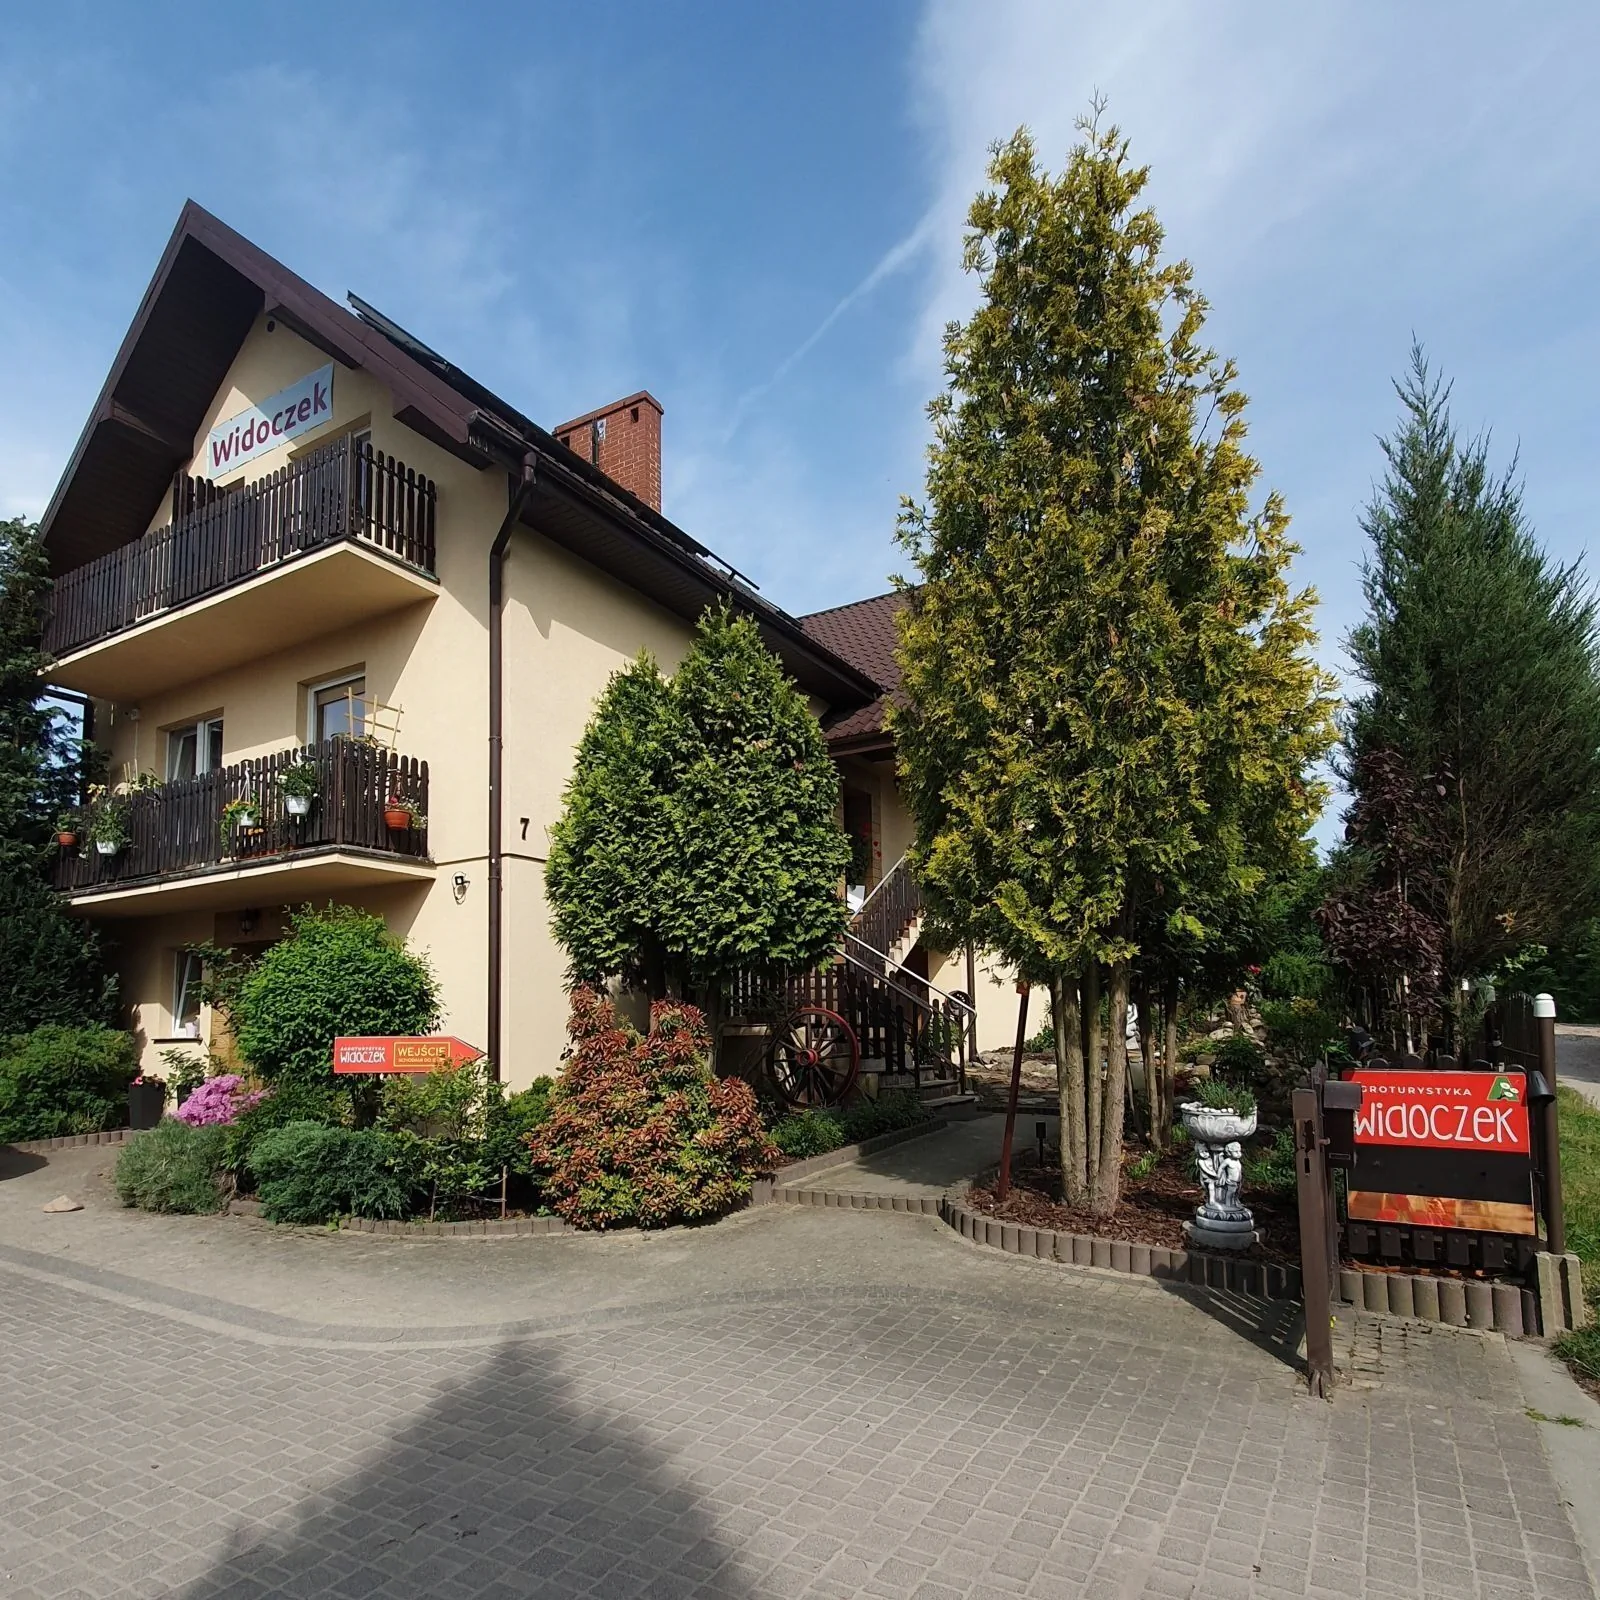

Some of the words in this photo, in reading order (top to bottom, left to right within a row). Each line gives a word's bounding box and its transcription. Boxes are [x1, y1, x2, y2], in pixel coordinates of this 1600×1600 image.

[520, 817, 530, 841] 7
[397, 1044, 446, 1057] WEJŚCIE
[1361, 1084, 1473, 1097] GROTURYSTYKA
